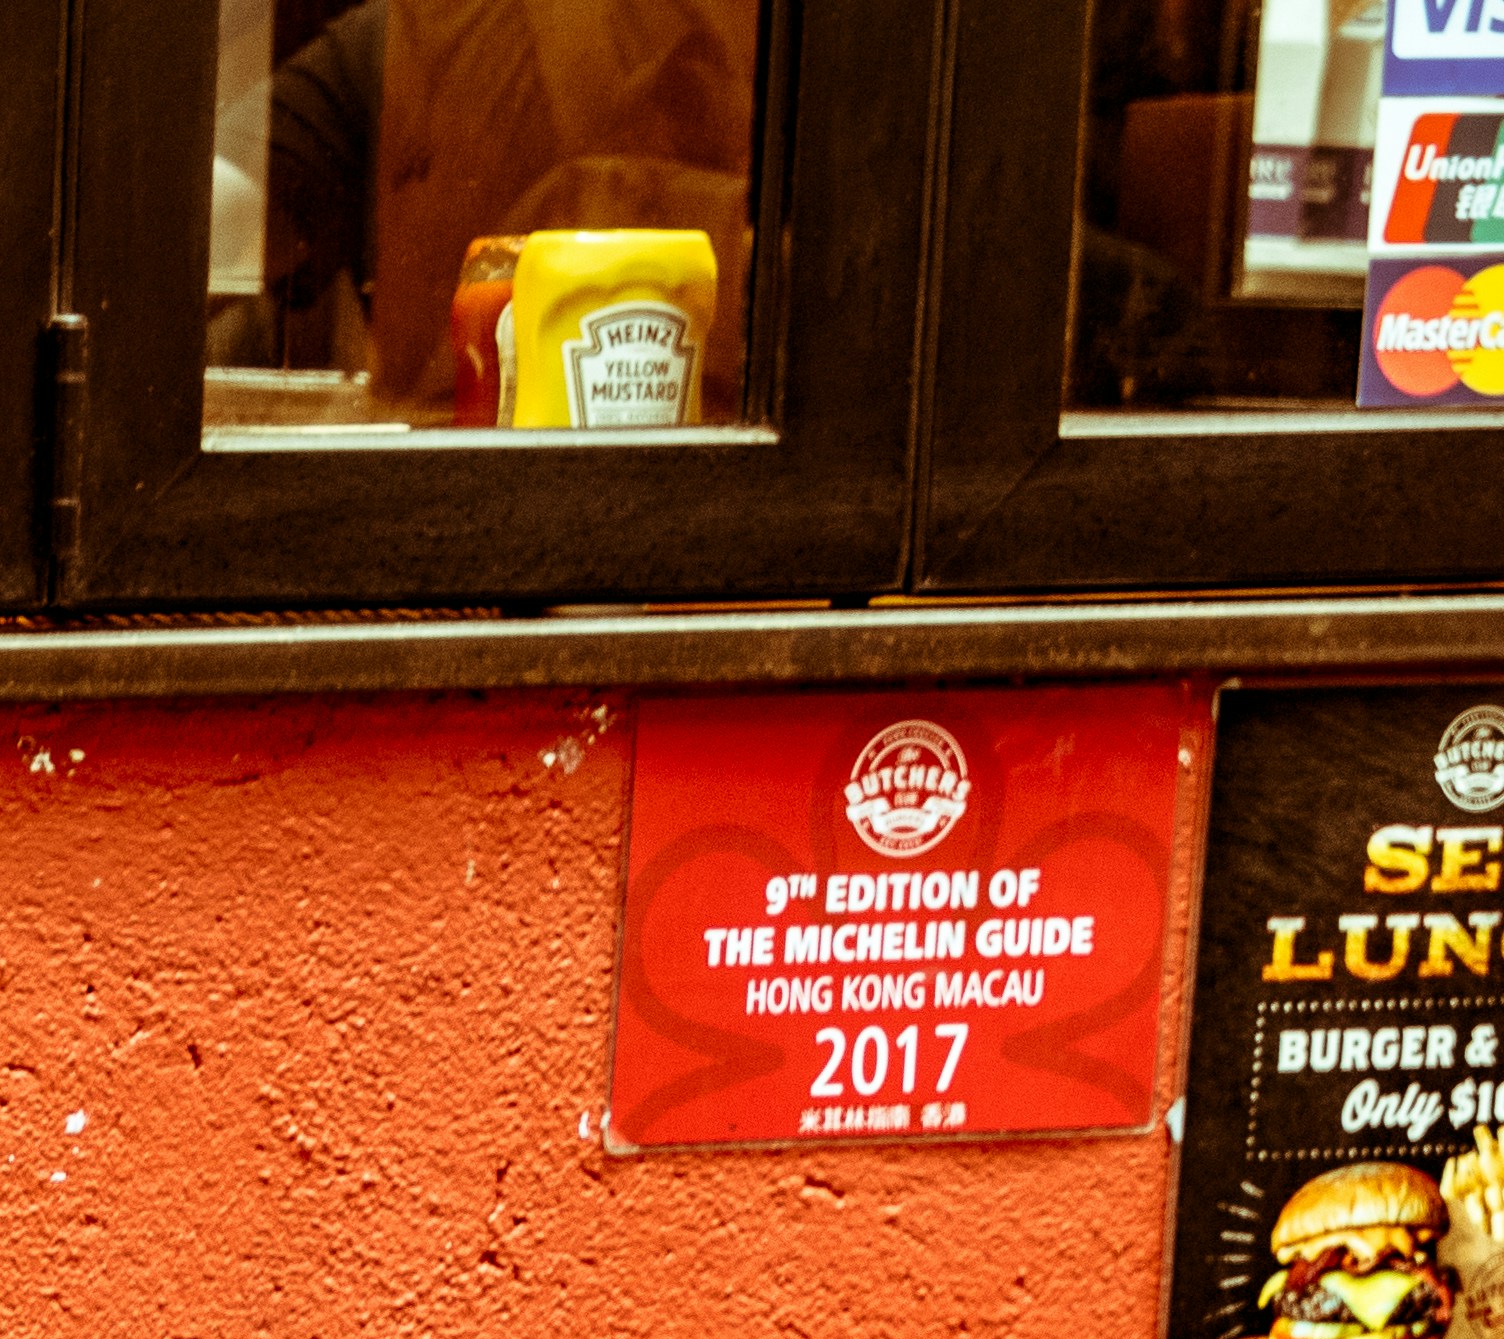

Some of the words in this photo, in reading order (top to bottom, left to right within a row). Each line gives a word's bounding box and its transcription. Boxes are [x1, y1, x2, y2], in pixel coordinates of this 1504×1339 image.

[1424, 0, 1504, 33] VI
[608, 324, 672, 348] HEINZ
[592, 382, 680, 402] MUSTARD
[606, 361, 670, 378] YELLOW
[765, 873, 816, 915] 9TH
[825, 871, 978, 913] EDITION
[989, 868, 1042, 909] OF
[704, 927, 775, 967] THE
[783, 920, 966, 964] MICHELIN
[975, 916, 1095, 958] GUIDE
[1261, 911, 1504, 983] LUN
[745, 975, 834, 1016] HONG
[841, 971, 927, 1012] KONG
[933, 968, 1046, 1009] MACAU
[809, 1022, 970, 1098] 2017
[1277, 1024, 1458, 1074] BURGER
[1464, 1022, 1500, 1070] &
[1341, 1078, 1445, 1143] Only
